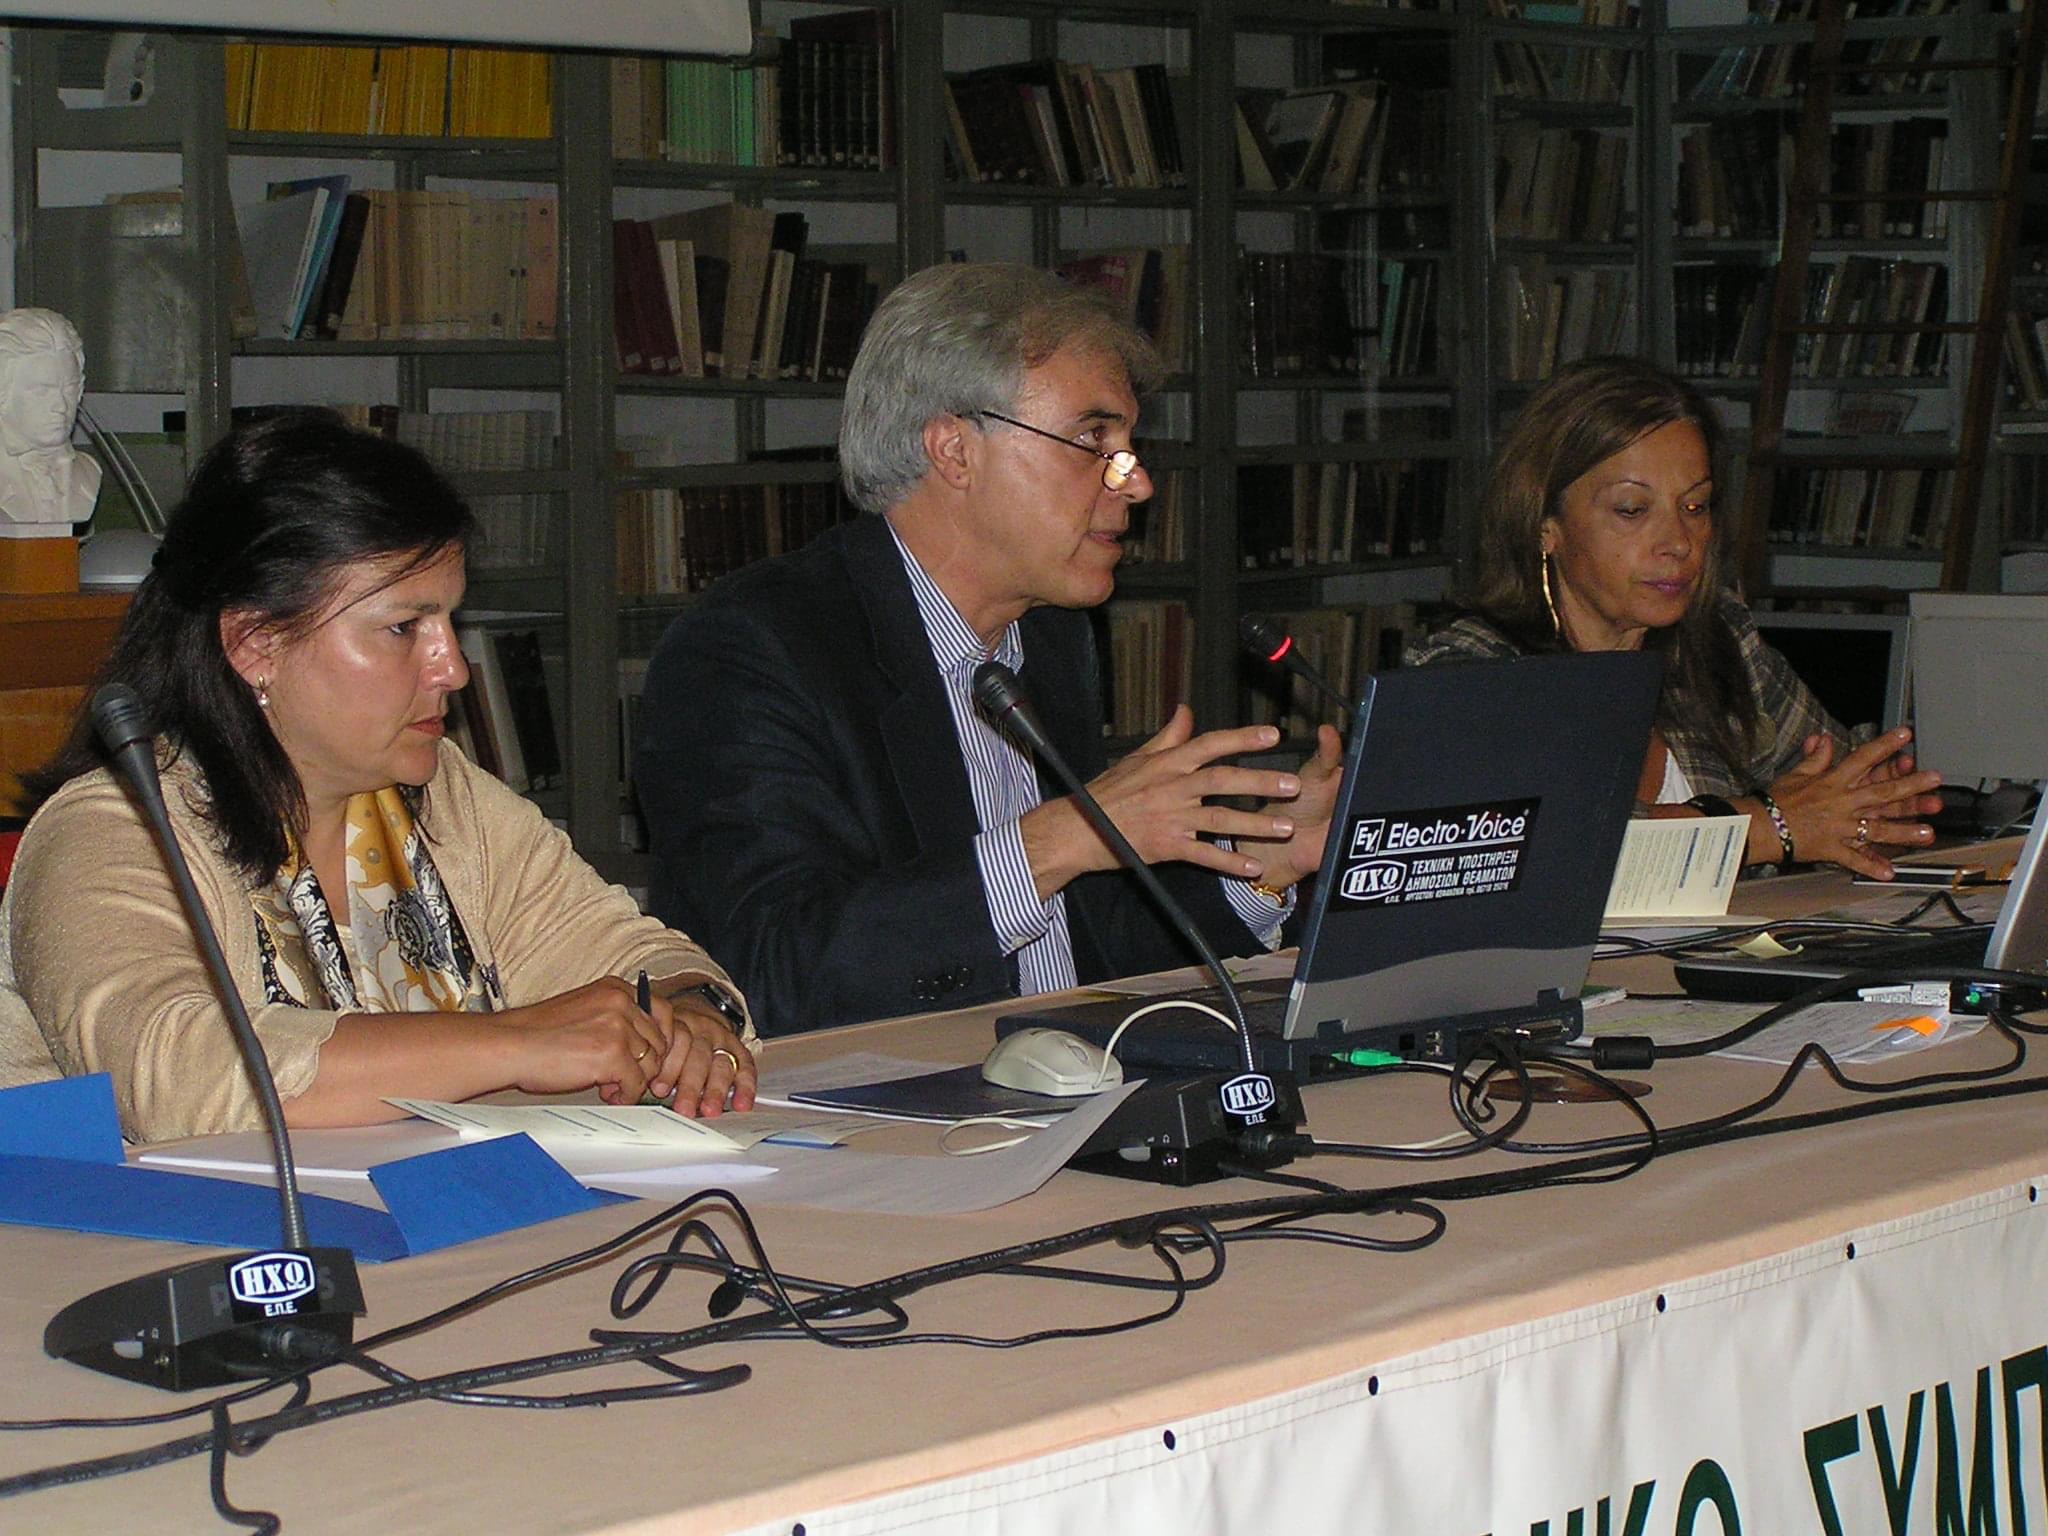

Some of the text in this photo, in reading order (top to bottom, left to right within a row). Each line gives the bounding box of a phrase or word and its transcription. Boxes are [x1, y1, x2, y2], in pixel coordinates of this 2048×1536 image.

[1412, 857, 1454, 874] ΤΕΧΝΙΚΗ
[1350, 867, 1398, 892] ΗΧΩ
[1405, 866, 1516, 891] ΔΗΜΟΣΙΩΝ ΘΕΑΜΑΤΩΝ
[1228, 1081, 1270, 1109] ΗΧΩ
[241, 1261, 306, 1297] ΗΧΩ
